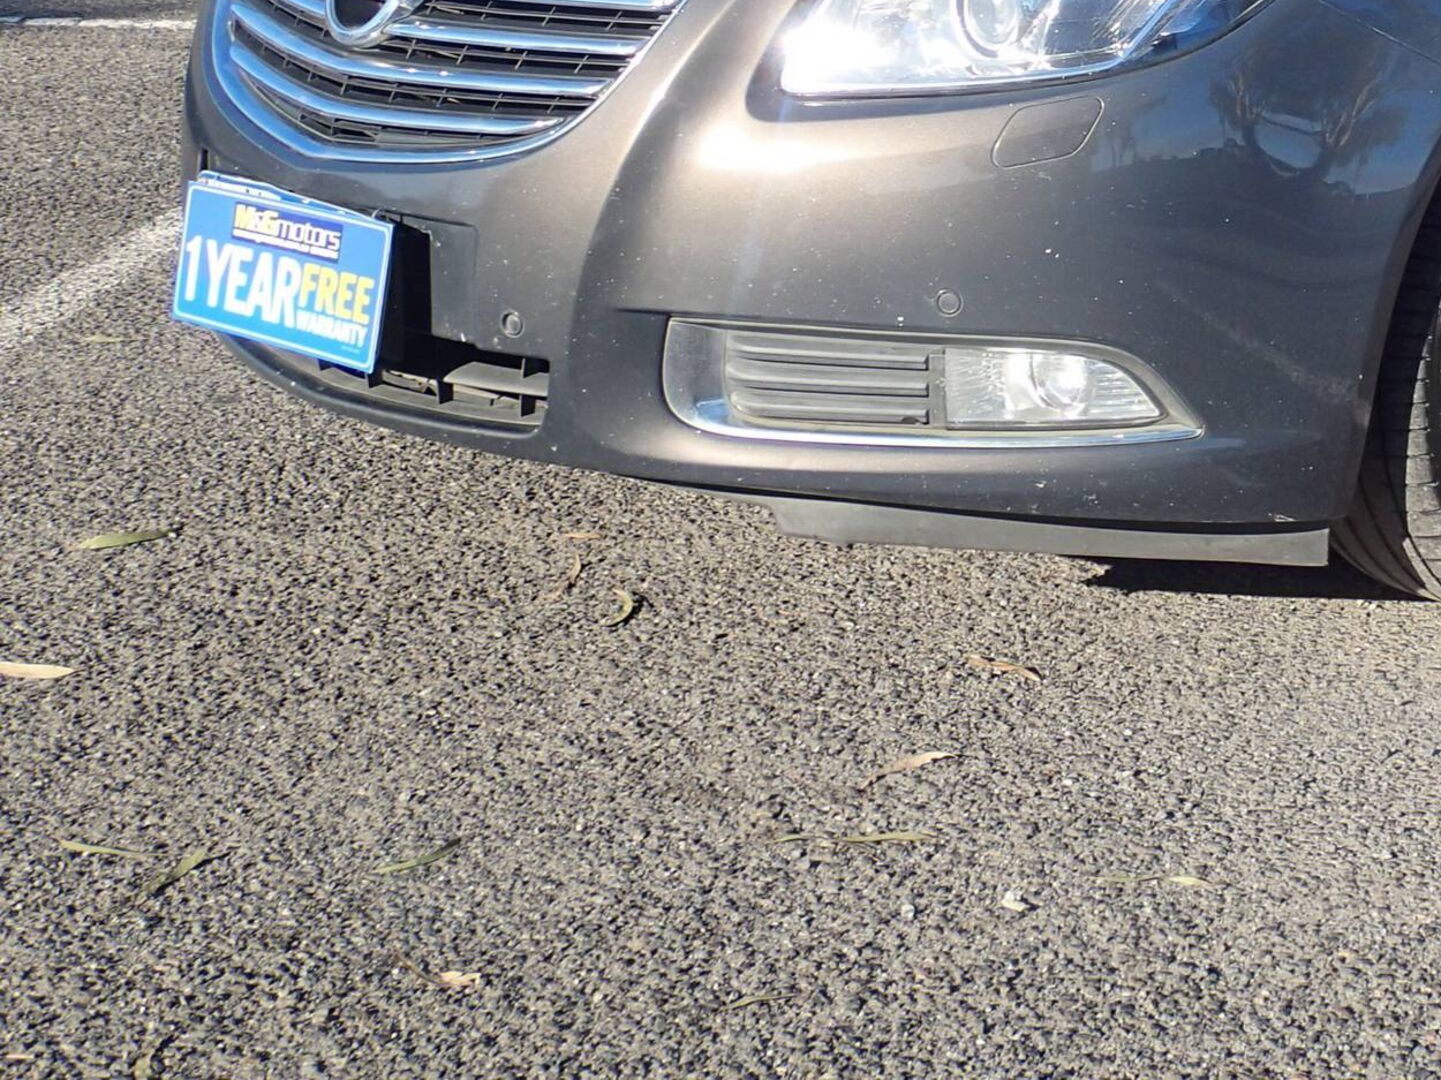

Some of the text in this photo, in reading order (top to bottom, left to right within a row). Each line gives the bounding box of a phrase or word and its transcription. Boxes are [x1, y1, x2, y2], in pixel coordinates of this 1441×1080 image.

[184, 235, 203, 302] 1
[207, 239, 302, 329] YEAR
[298, 262, 375, 325] FREE
[296, 309, 368, 348] WARRANTY
